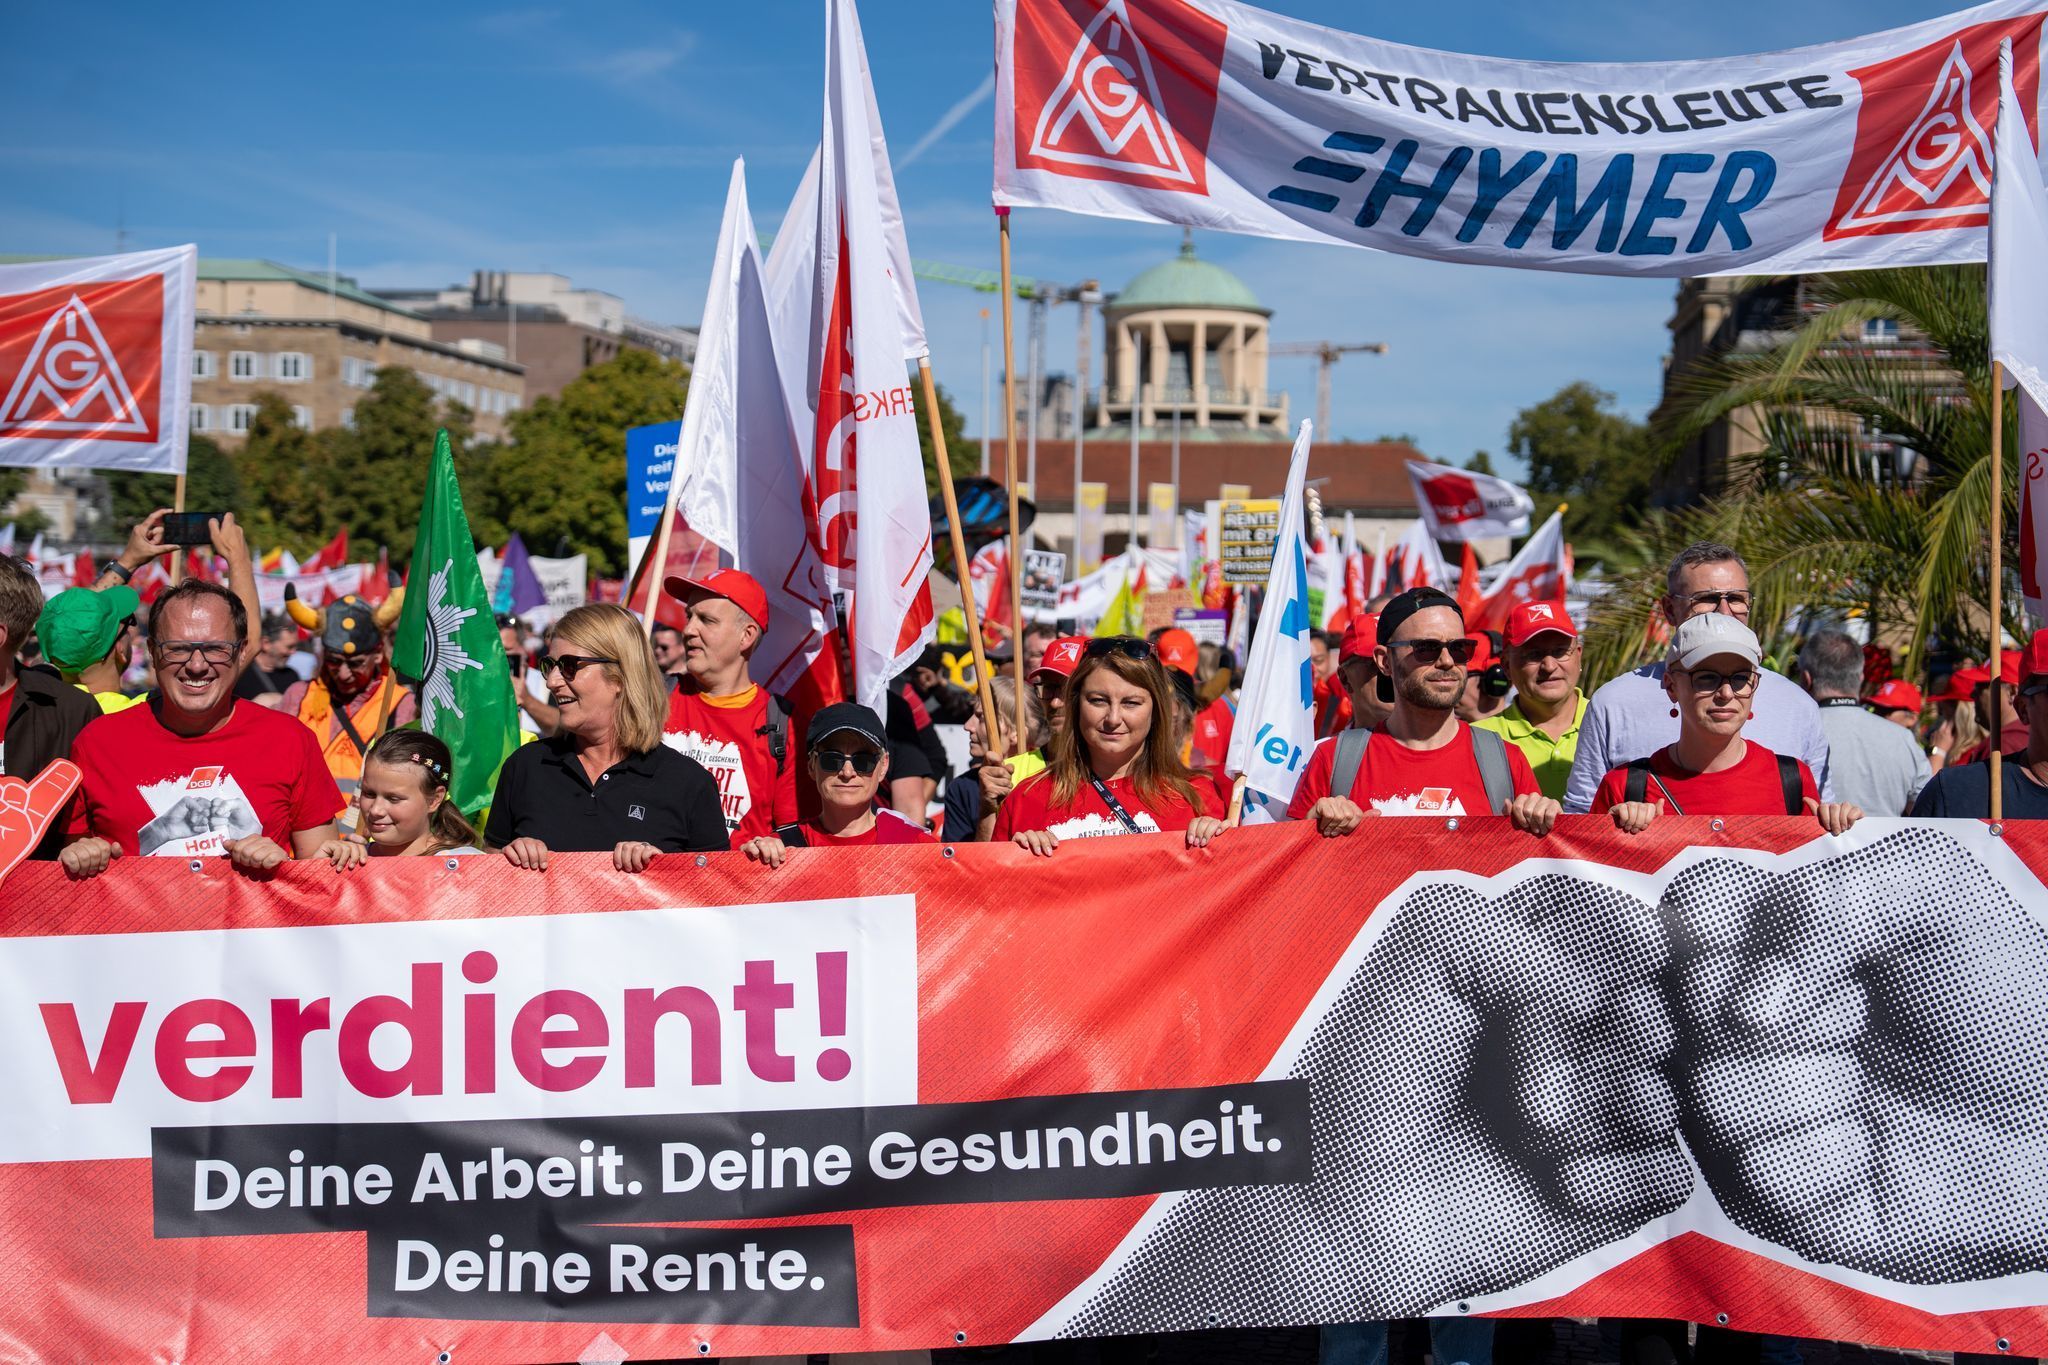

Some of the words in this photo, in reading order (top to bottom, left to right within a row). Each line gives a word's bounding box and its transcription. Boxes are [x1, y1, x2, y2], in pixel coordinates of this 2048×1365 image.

[1255, 39, 1844, 135] VERTRAUENSLEUTE
[1355, 139, 1777, 256] HYMER
[1224, 512, 1278, 526] RENTE
[190, 780, 211, 788] DGB
[708, 755, 739, 765] GESCHENKT
[1419, 800, 1440, 809] DGB
[38, 950, 852, 1105] verdient!
[193, 1149, 393, 1212] Deine
[411, 1139, 643, 1203] Arbeit.
[662, 1132, 852, 1194] Deine
[868, 1100, 1283, 1181] Gesundheit.
[395, 1234, 591, 1294] Deine
[610, 1243, 826, 1293] Rente.
